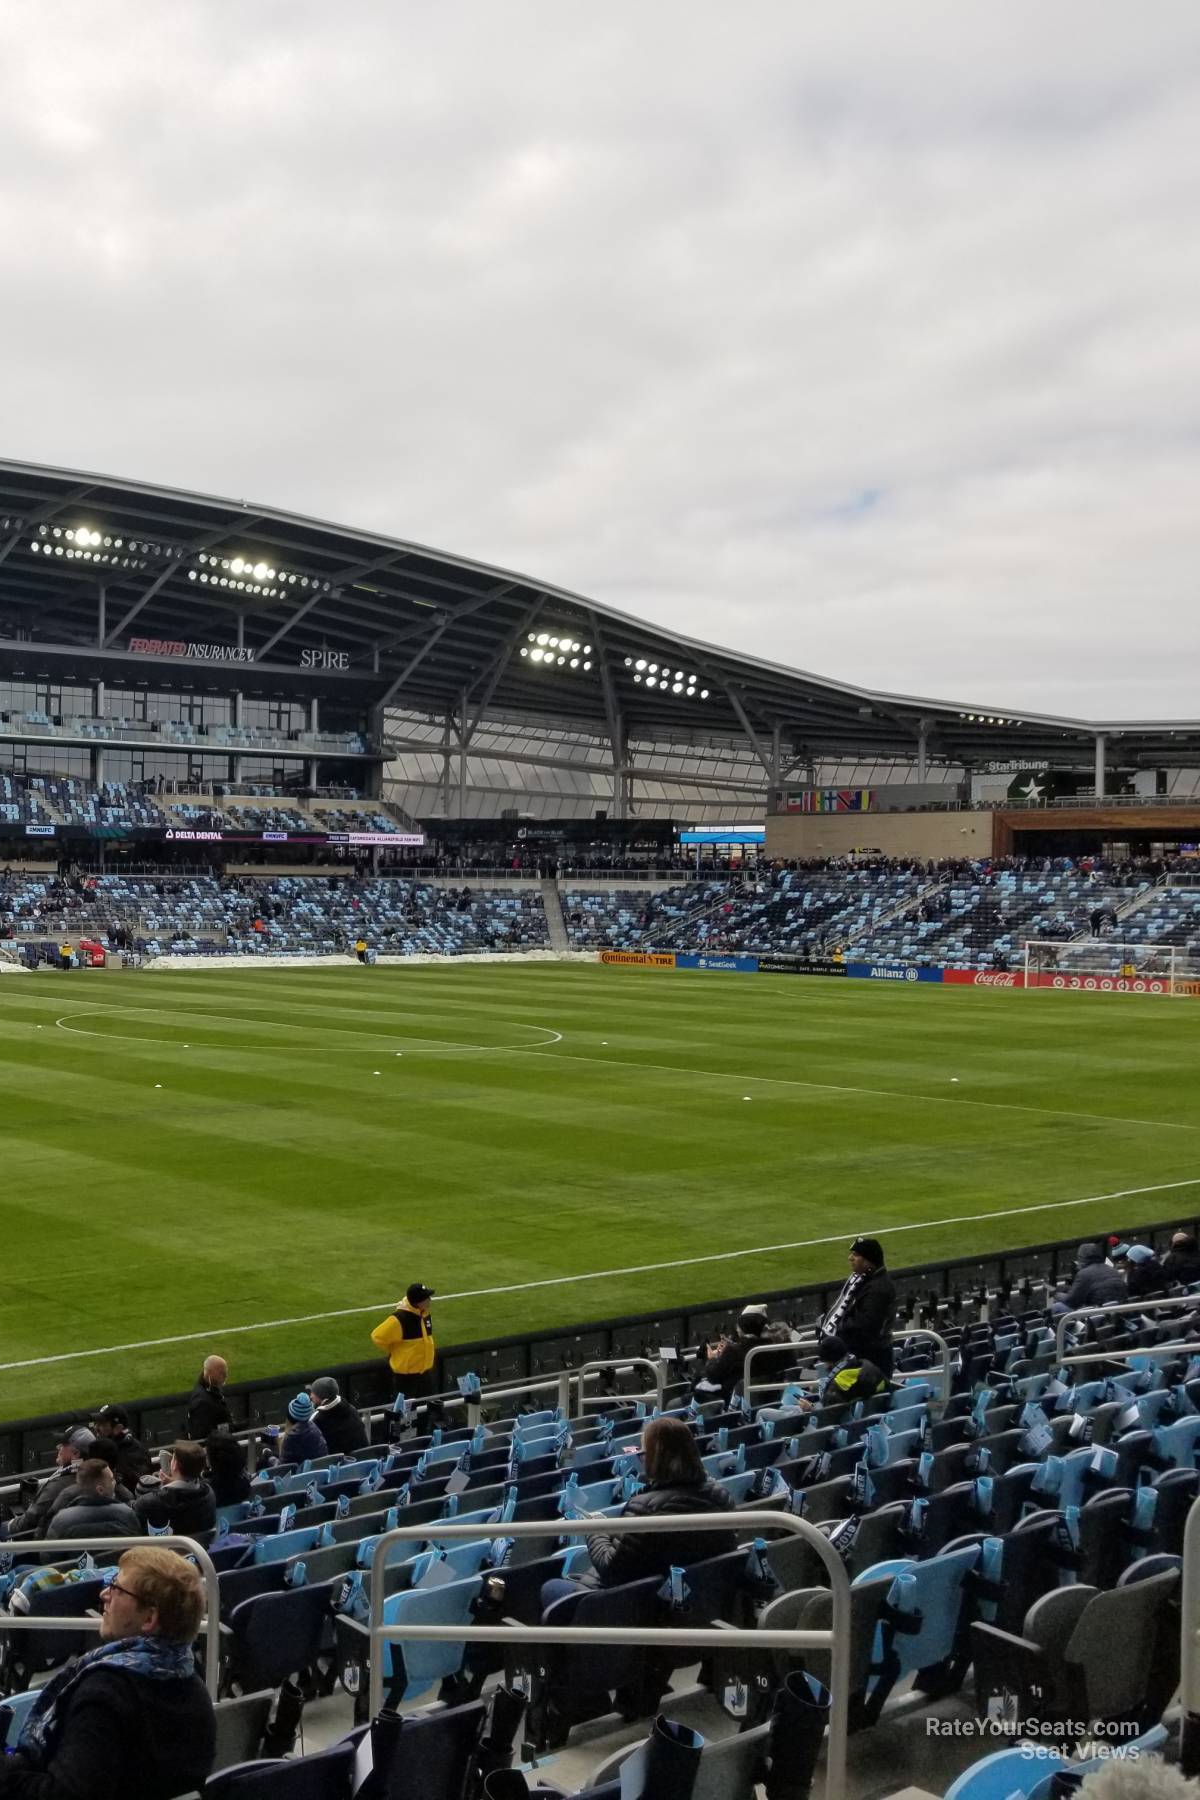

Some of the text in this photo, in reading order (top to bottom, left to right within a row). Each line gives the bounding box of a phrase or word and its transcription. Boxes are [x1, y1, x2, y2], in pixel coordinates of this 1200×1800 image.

[129, 638, 247, 661] FEDERATED INSURANCE
[300, 650, 349, 669] SPIRE
[175, 831, 223, 840] DELTA DENTAL
[601, 952, 673, 966] Continental TIRE
[708, 960, 737, 969] SeatGeek
[871, 967, 904, 979] Allianz
[835, 1524, 857, 1550] 2019
[540, 1667, 545, 1676] 9
[756, 1675, 768, 1688] 10
[1030, 1684, 1042, 1698] 11
